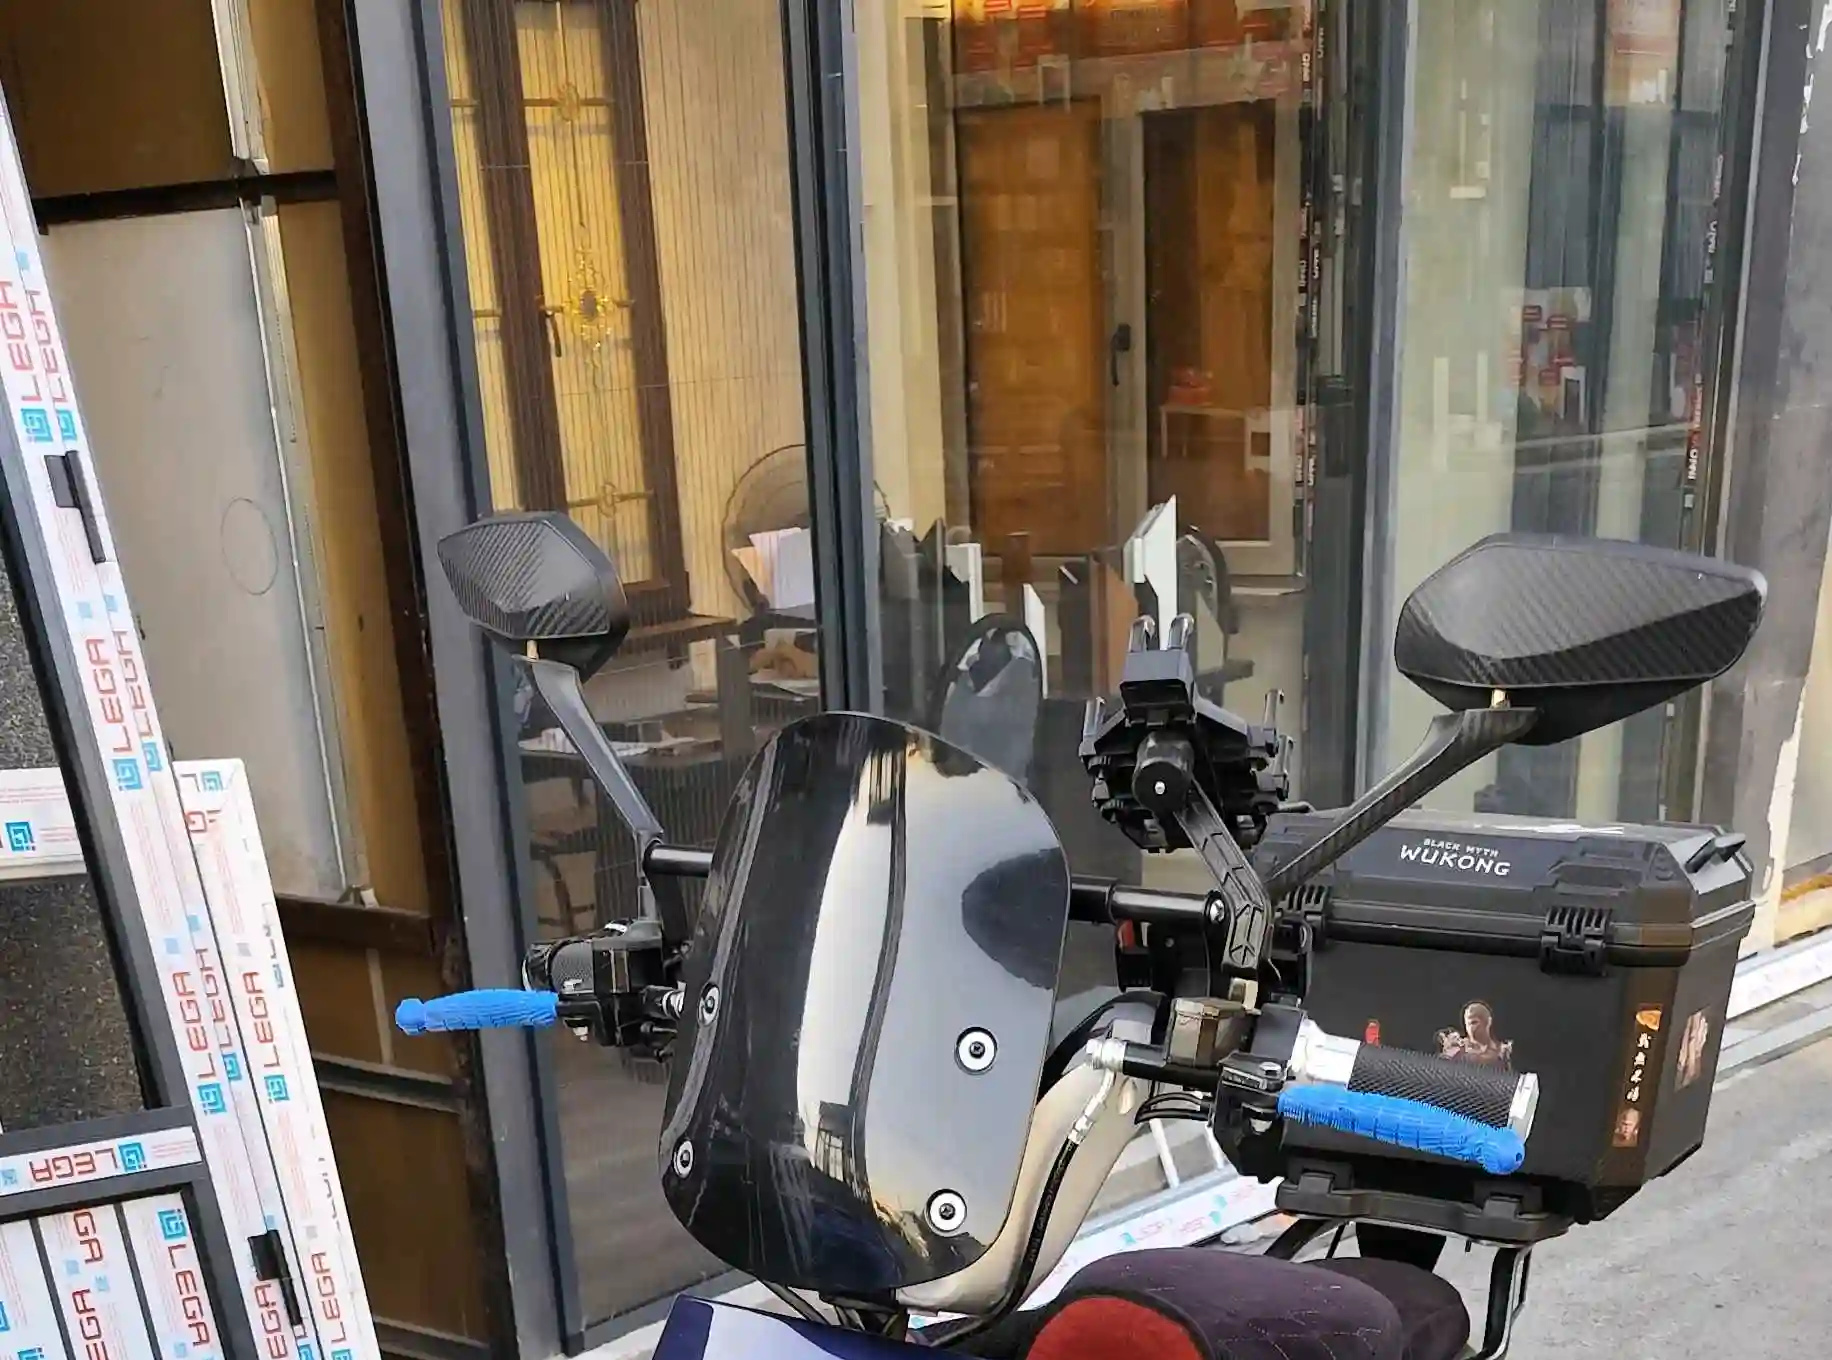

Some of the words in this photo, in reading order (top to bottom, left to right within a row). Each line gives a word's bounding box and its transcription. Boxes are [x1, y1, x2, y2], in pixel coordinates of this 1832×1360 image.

[0, 281, 42, 401] LEGA
[86, 639, 133, 753] LEGA
[1400, 844, 1511, 876] WUKONG
[1423, 838, 1460, 850] BLACK
[1466, 845, 1499, 857] MYTH
[173, 972, 215, 1078] LEGA
[243, 972, 281, 1067] LEGA
[29, 1148, 119, 1182] LEGA
[168, 1244, 210, 1348] LEGA
[311, 1252, 346, 1343] LEGA
